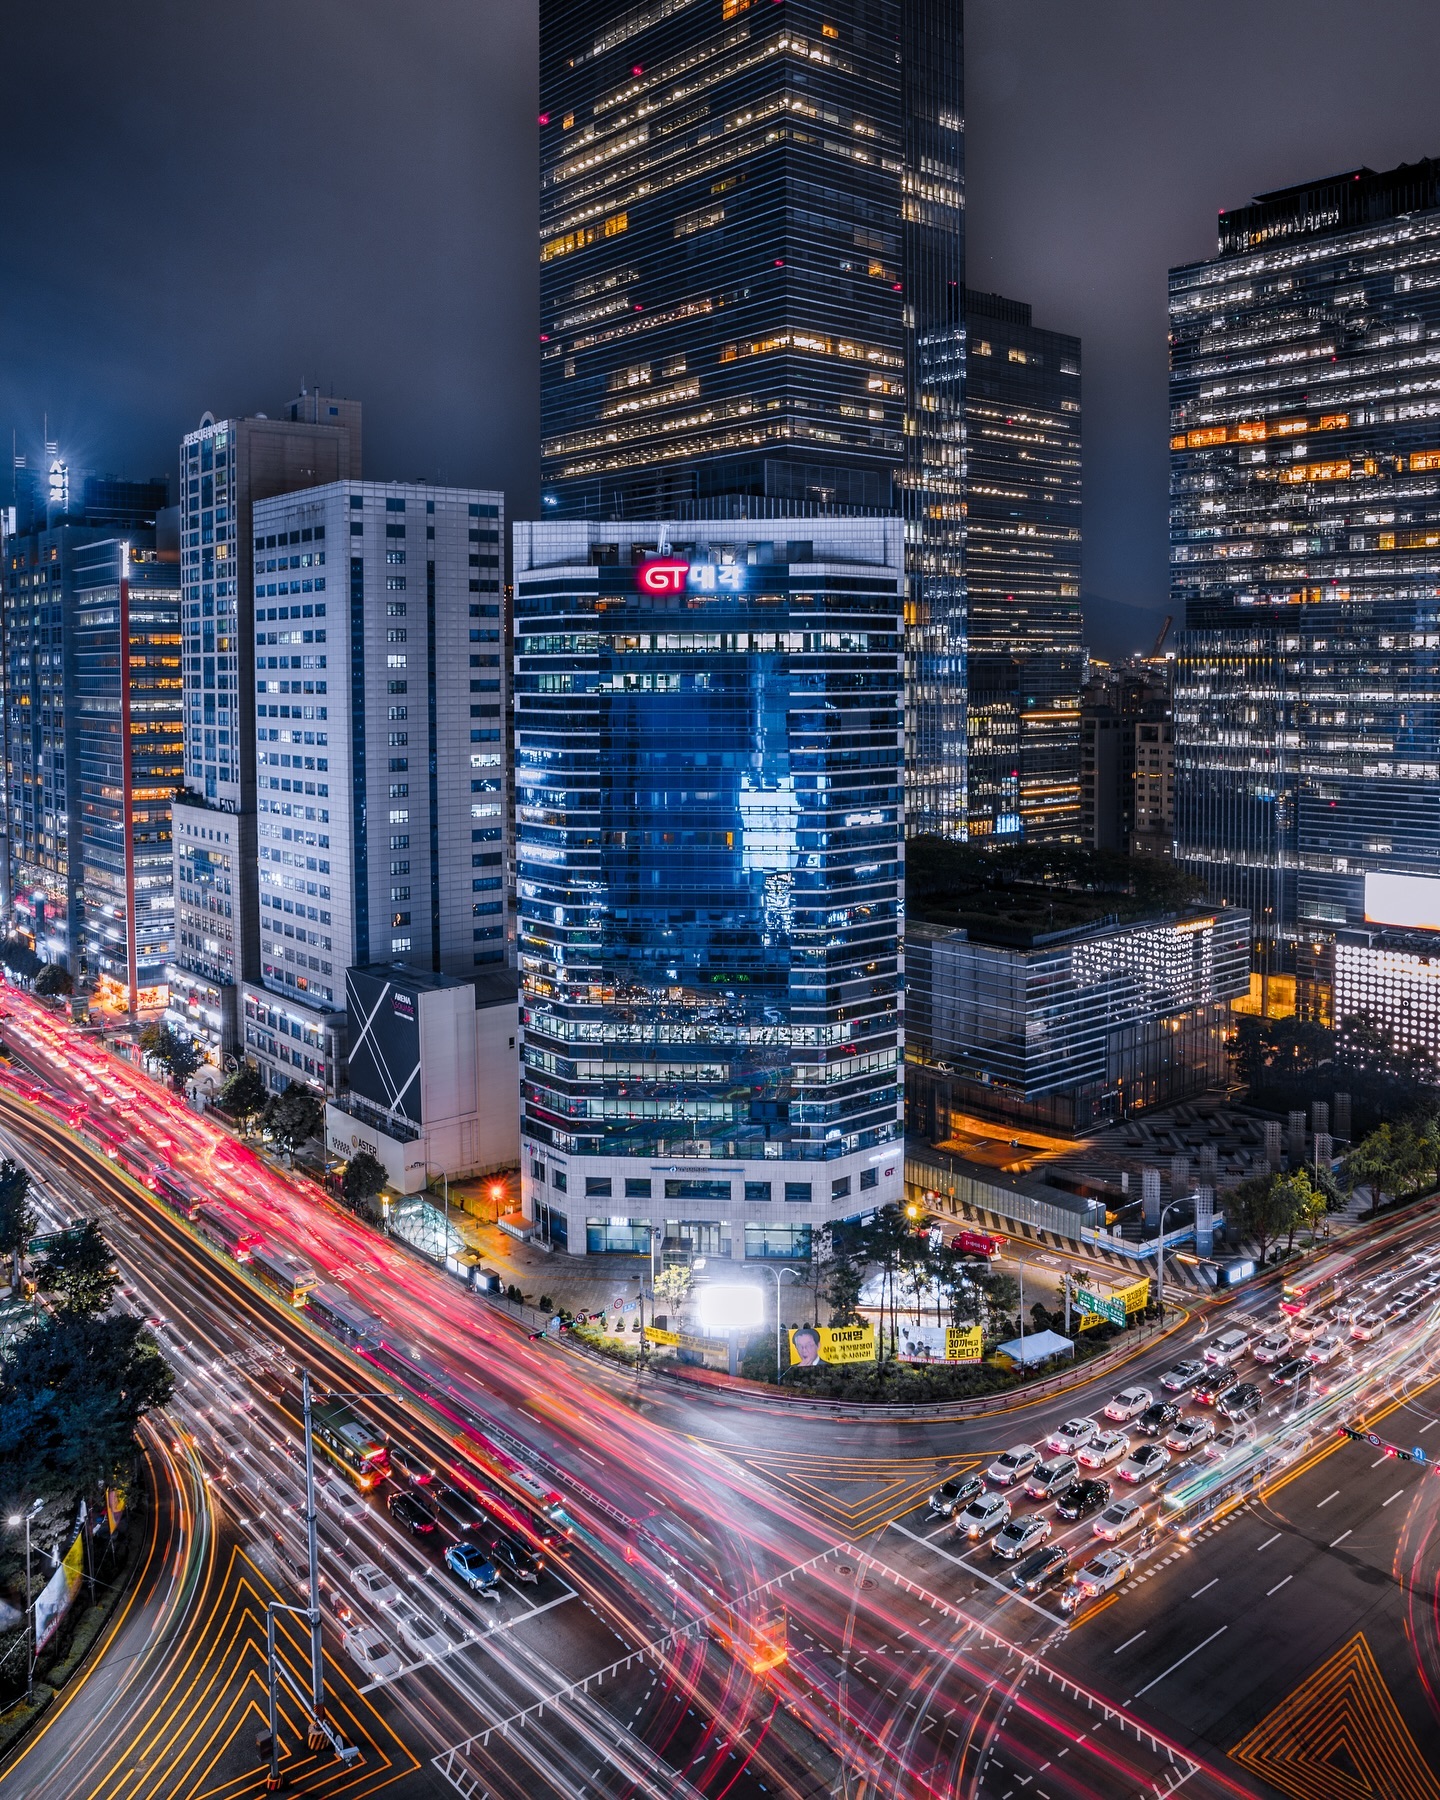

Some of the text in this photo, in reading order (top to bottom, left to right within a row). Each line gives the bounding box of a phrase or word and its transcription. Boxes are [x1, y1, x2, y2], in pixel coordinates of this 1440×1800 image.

[358, 1138, 377, 1157] ASTER
[328, 1267, 353, 1280] 50
[355, 1261, 380, 1274] 50
[831, 1330, 863, 1342] 이재명
[949, 1347, 979, 1358] 모른다?
